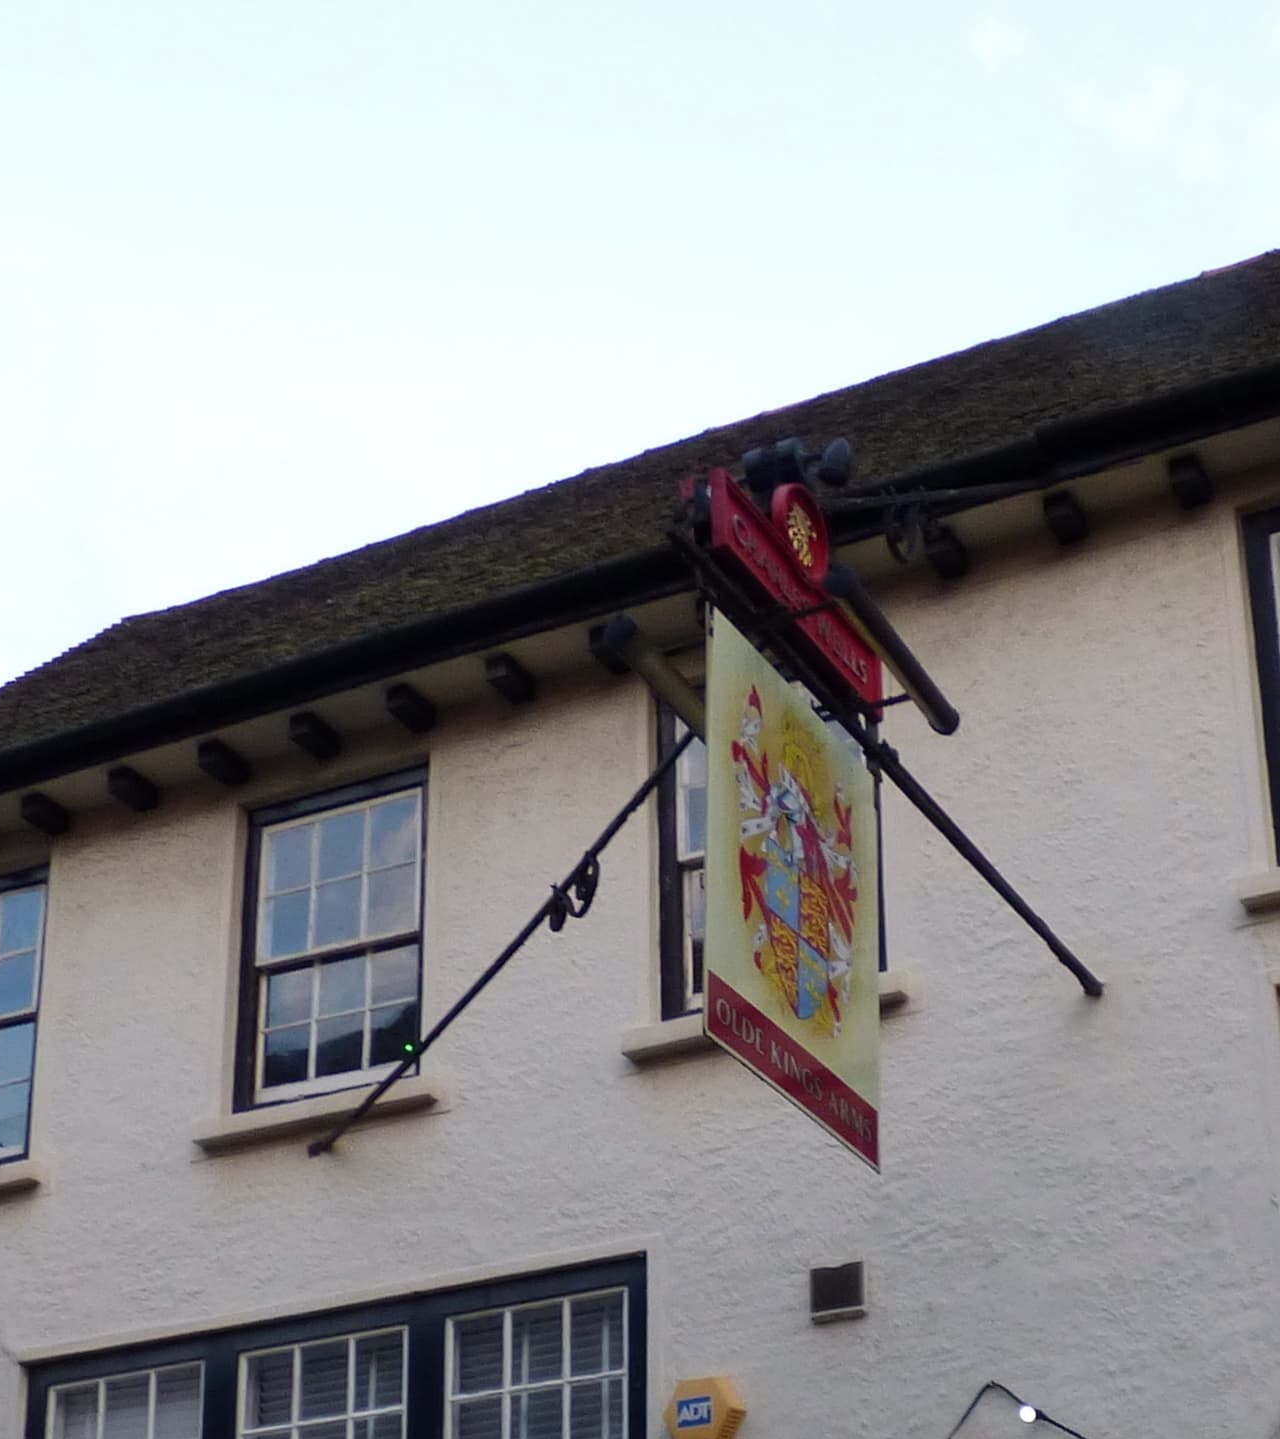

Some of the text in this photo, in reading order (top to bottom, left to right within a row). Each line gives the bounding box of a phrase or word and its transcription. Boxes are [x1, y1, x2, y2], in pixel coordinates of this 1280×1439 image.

[716, 999, 872, 1143] OLDE KINGS ARMS
[679, 1401, 711, 1422] ADT
